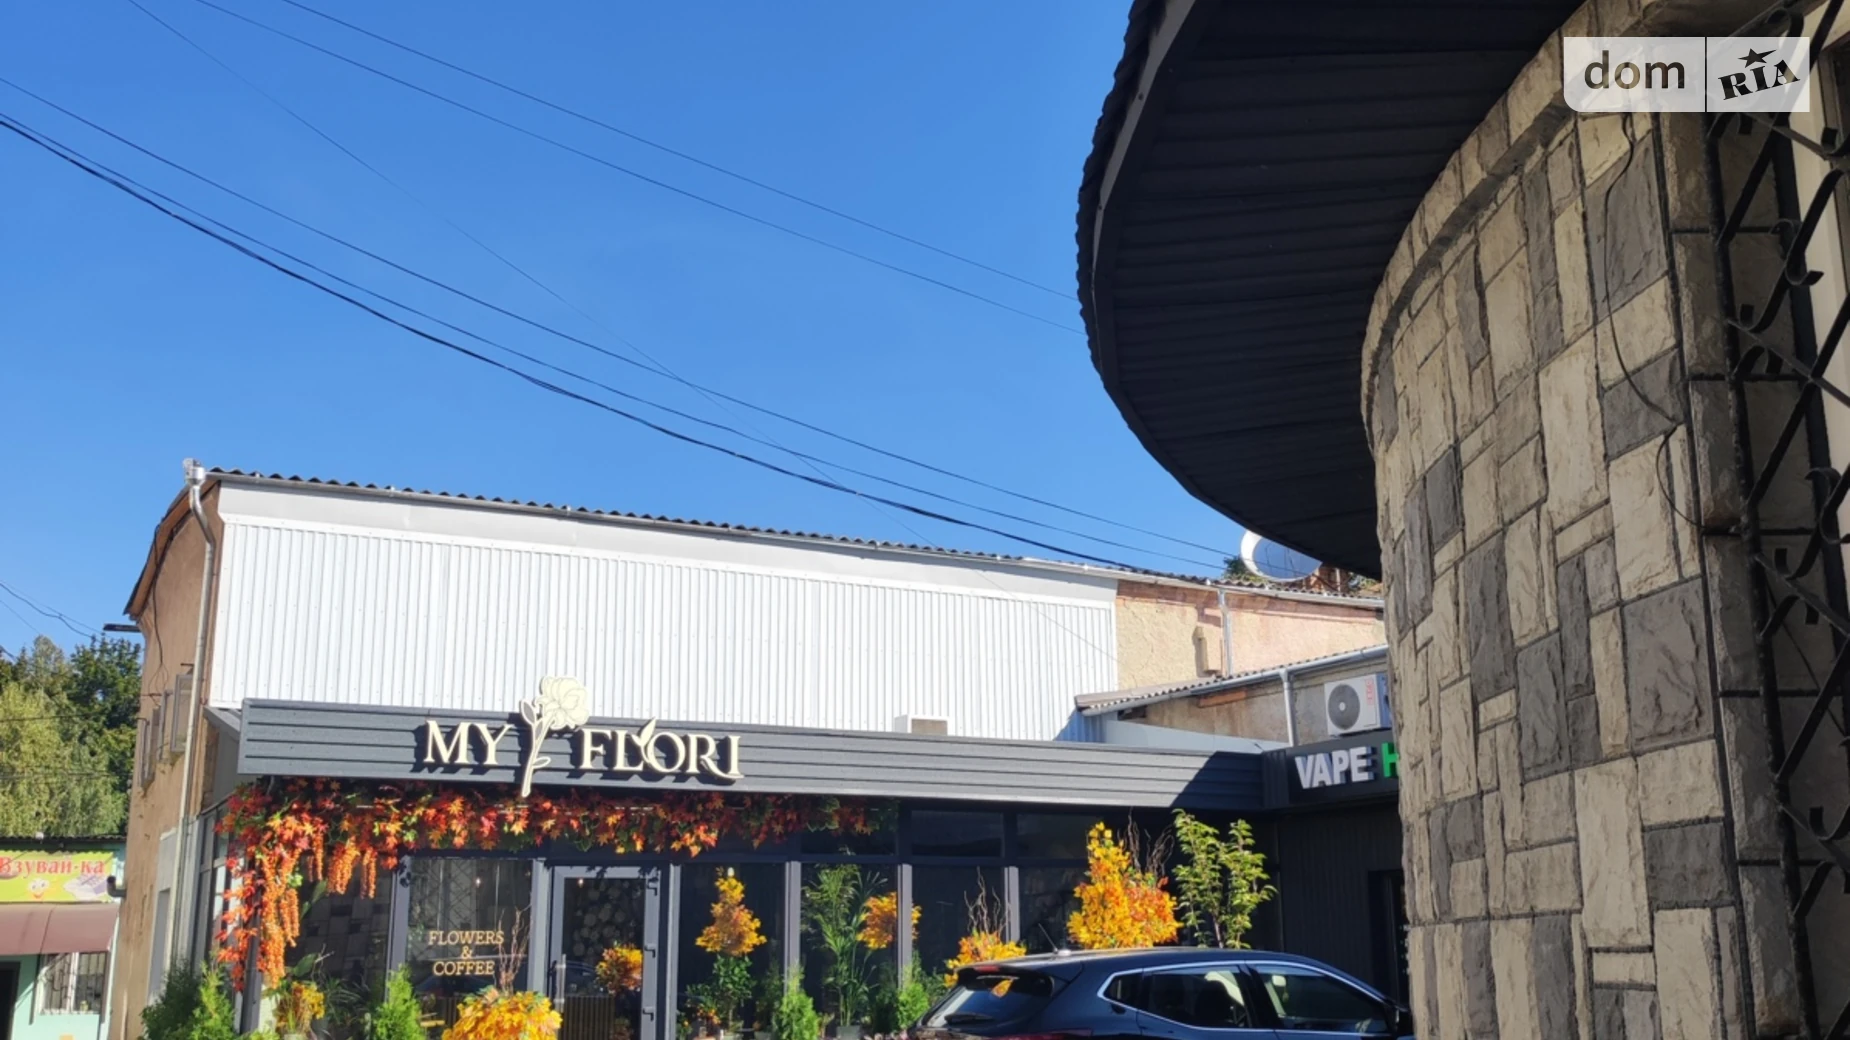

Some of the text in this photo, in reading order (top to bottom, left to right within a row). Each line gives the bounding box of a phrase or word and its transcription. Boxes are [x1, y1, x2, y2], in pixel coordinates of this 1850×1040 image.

[424, 717, 745, 779] MY FLORI
[1295, 746, 1374, 789] VAPE
[428, 930, 504, 945] FLOWERS
[461, 945, 472, 959] &
[433, 961, 495, 976] COFFEE
